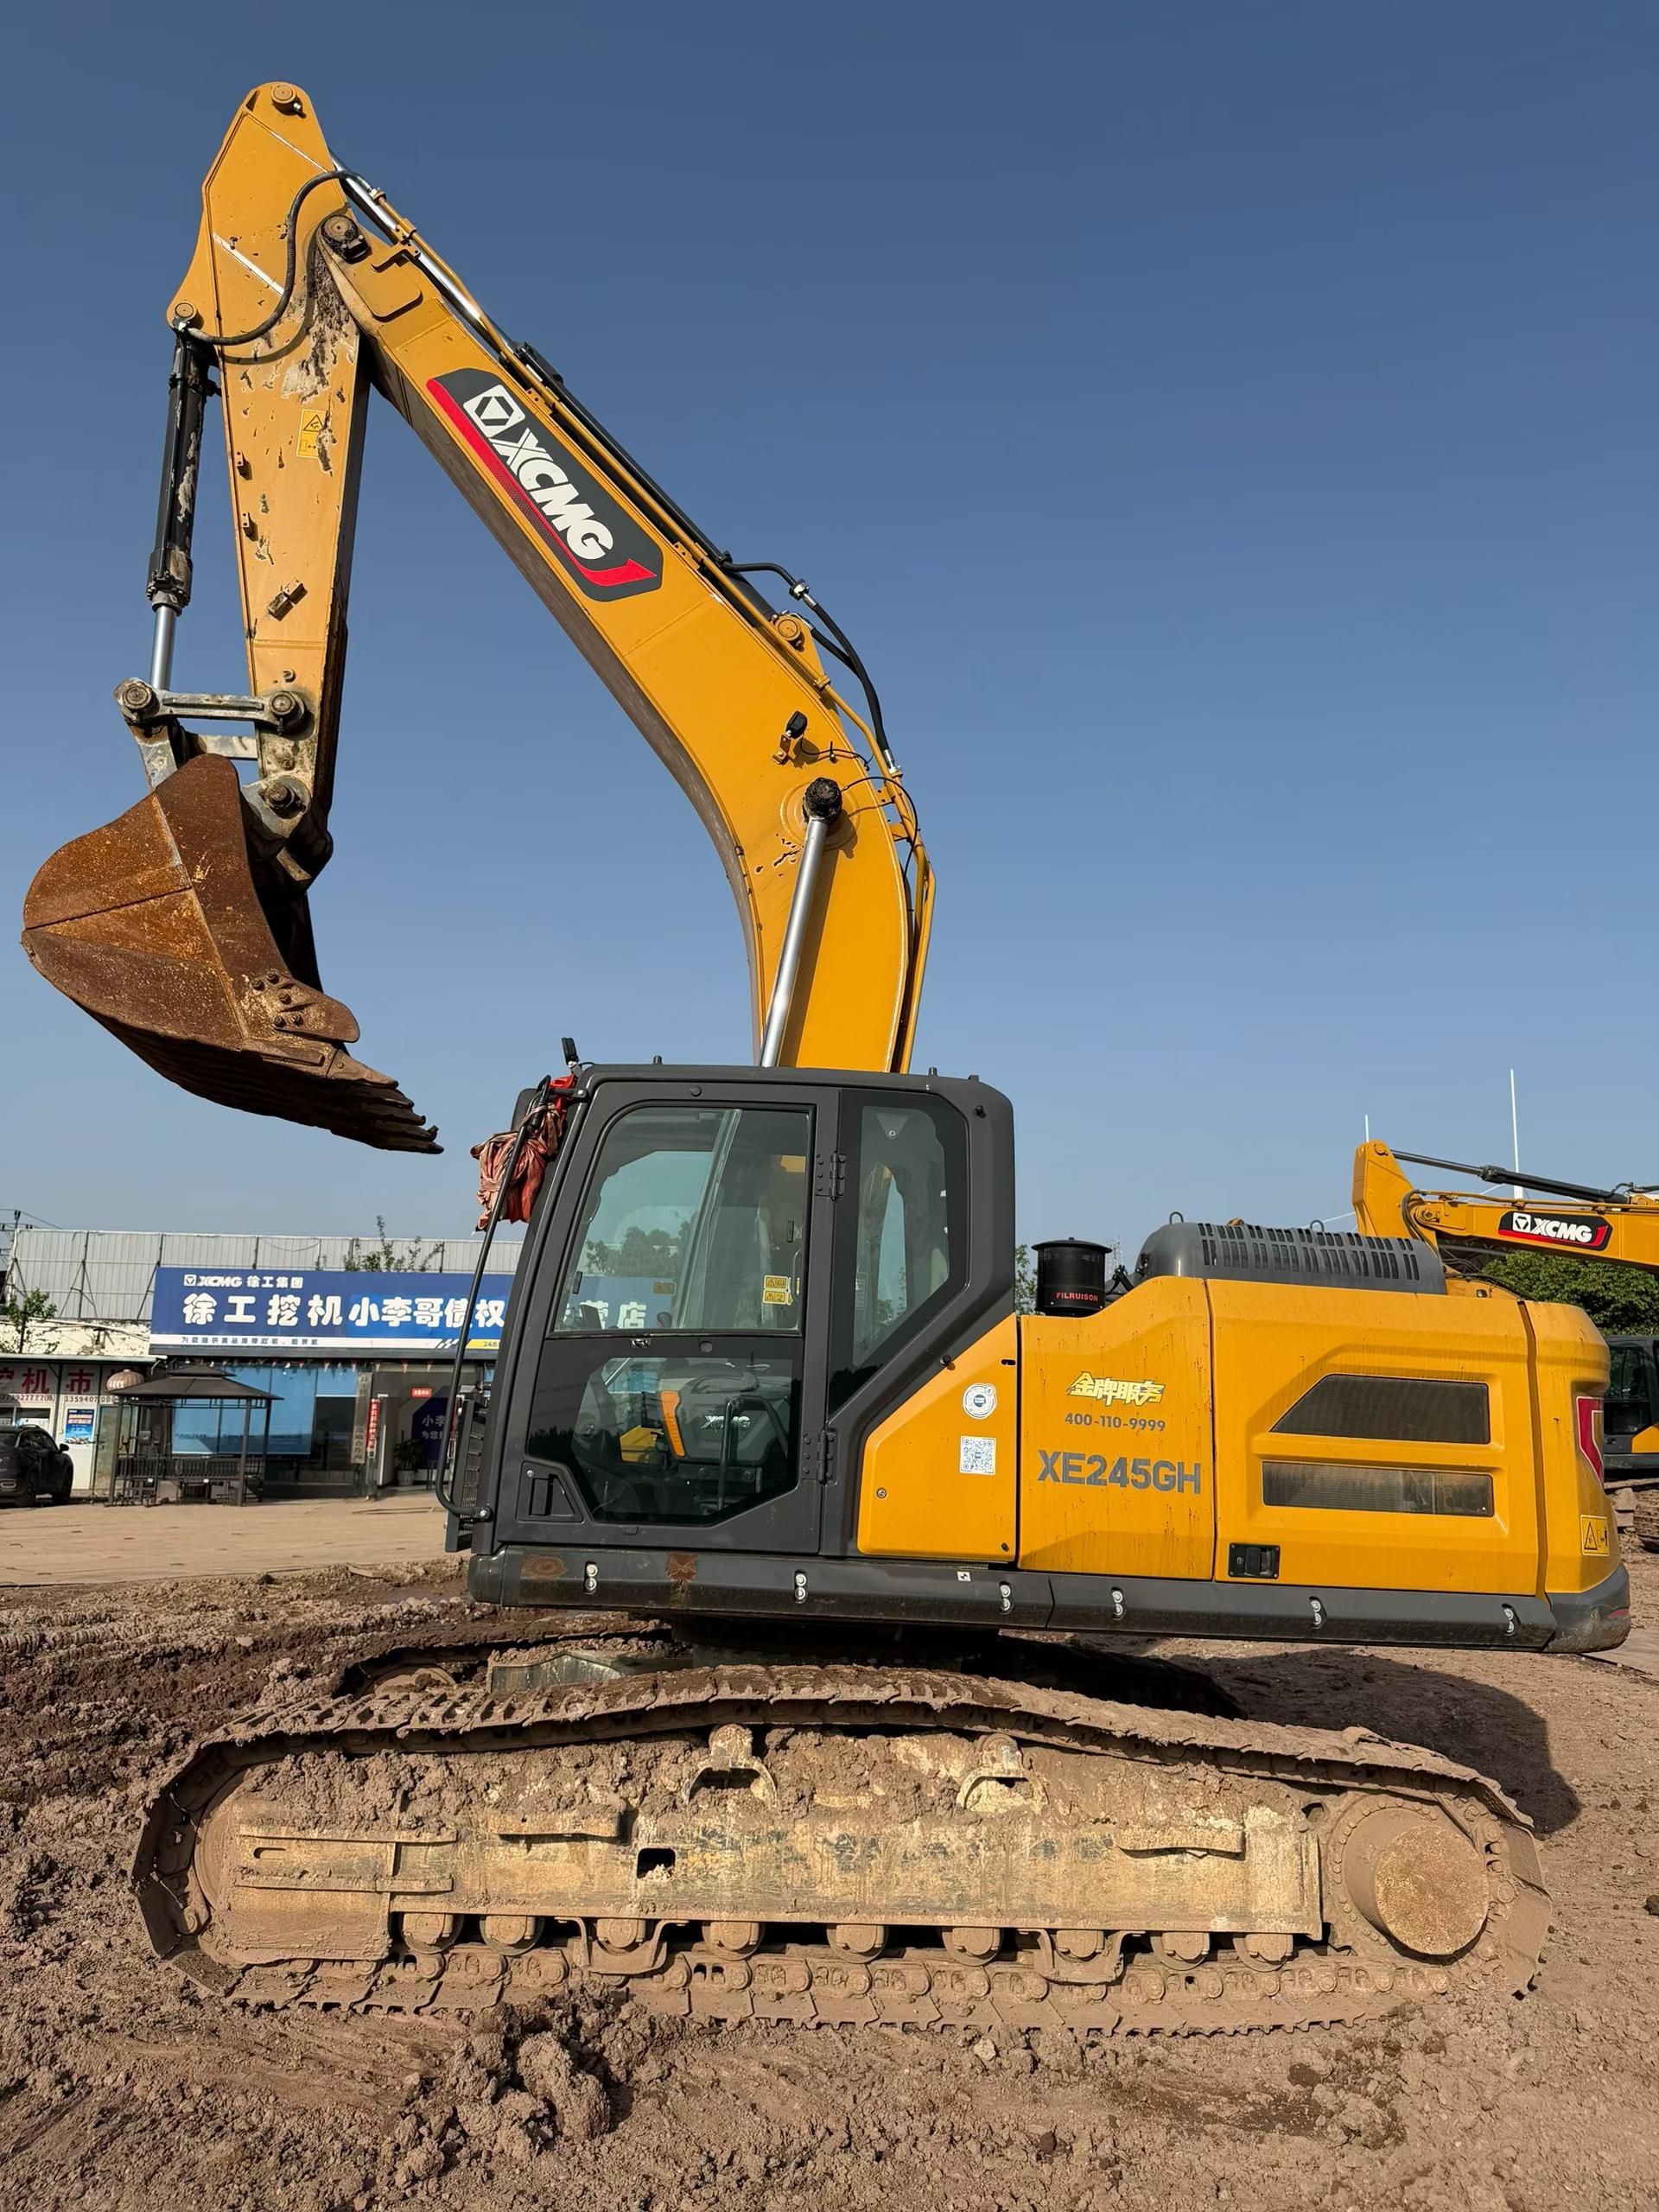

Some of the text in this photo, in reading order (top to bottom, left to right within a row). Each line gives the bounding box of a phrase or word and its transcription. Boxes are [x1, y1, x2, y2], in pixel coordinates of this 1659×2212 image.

[488, 428, 613, 560] XCMG
[1530, 1217, 1592, 1243] XCMG
[197, 1275, 303, 1288] XCMG 徐工集团
[1056, 1292, 1098, 1301] FILRUISON
[1067, 1371, 1166, 1406] 金牌服务
[1065, 1413, 1166, 1432] 400-110-9999
[1037, 1450, 1201, 1495] XE245GH
